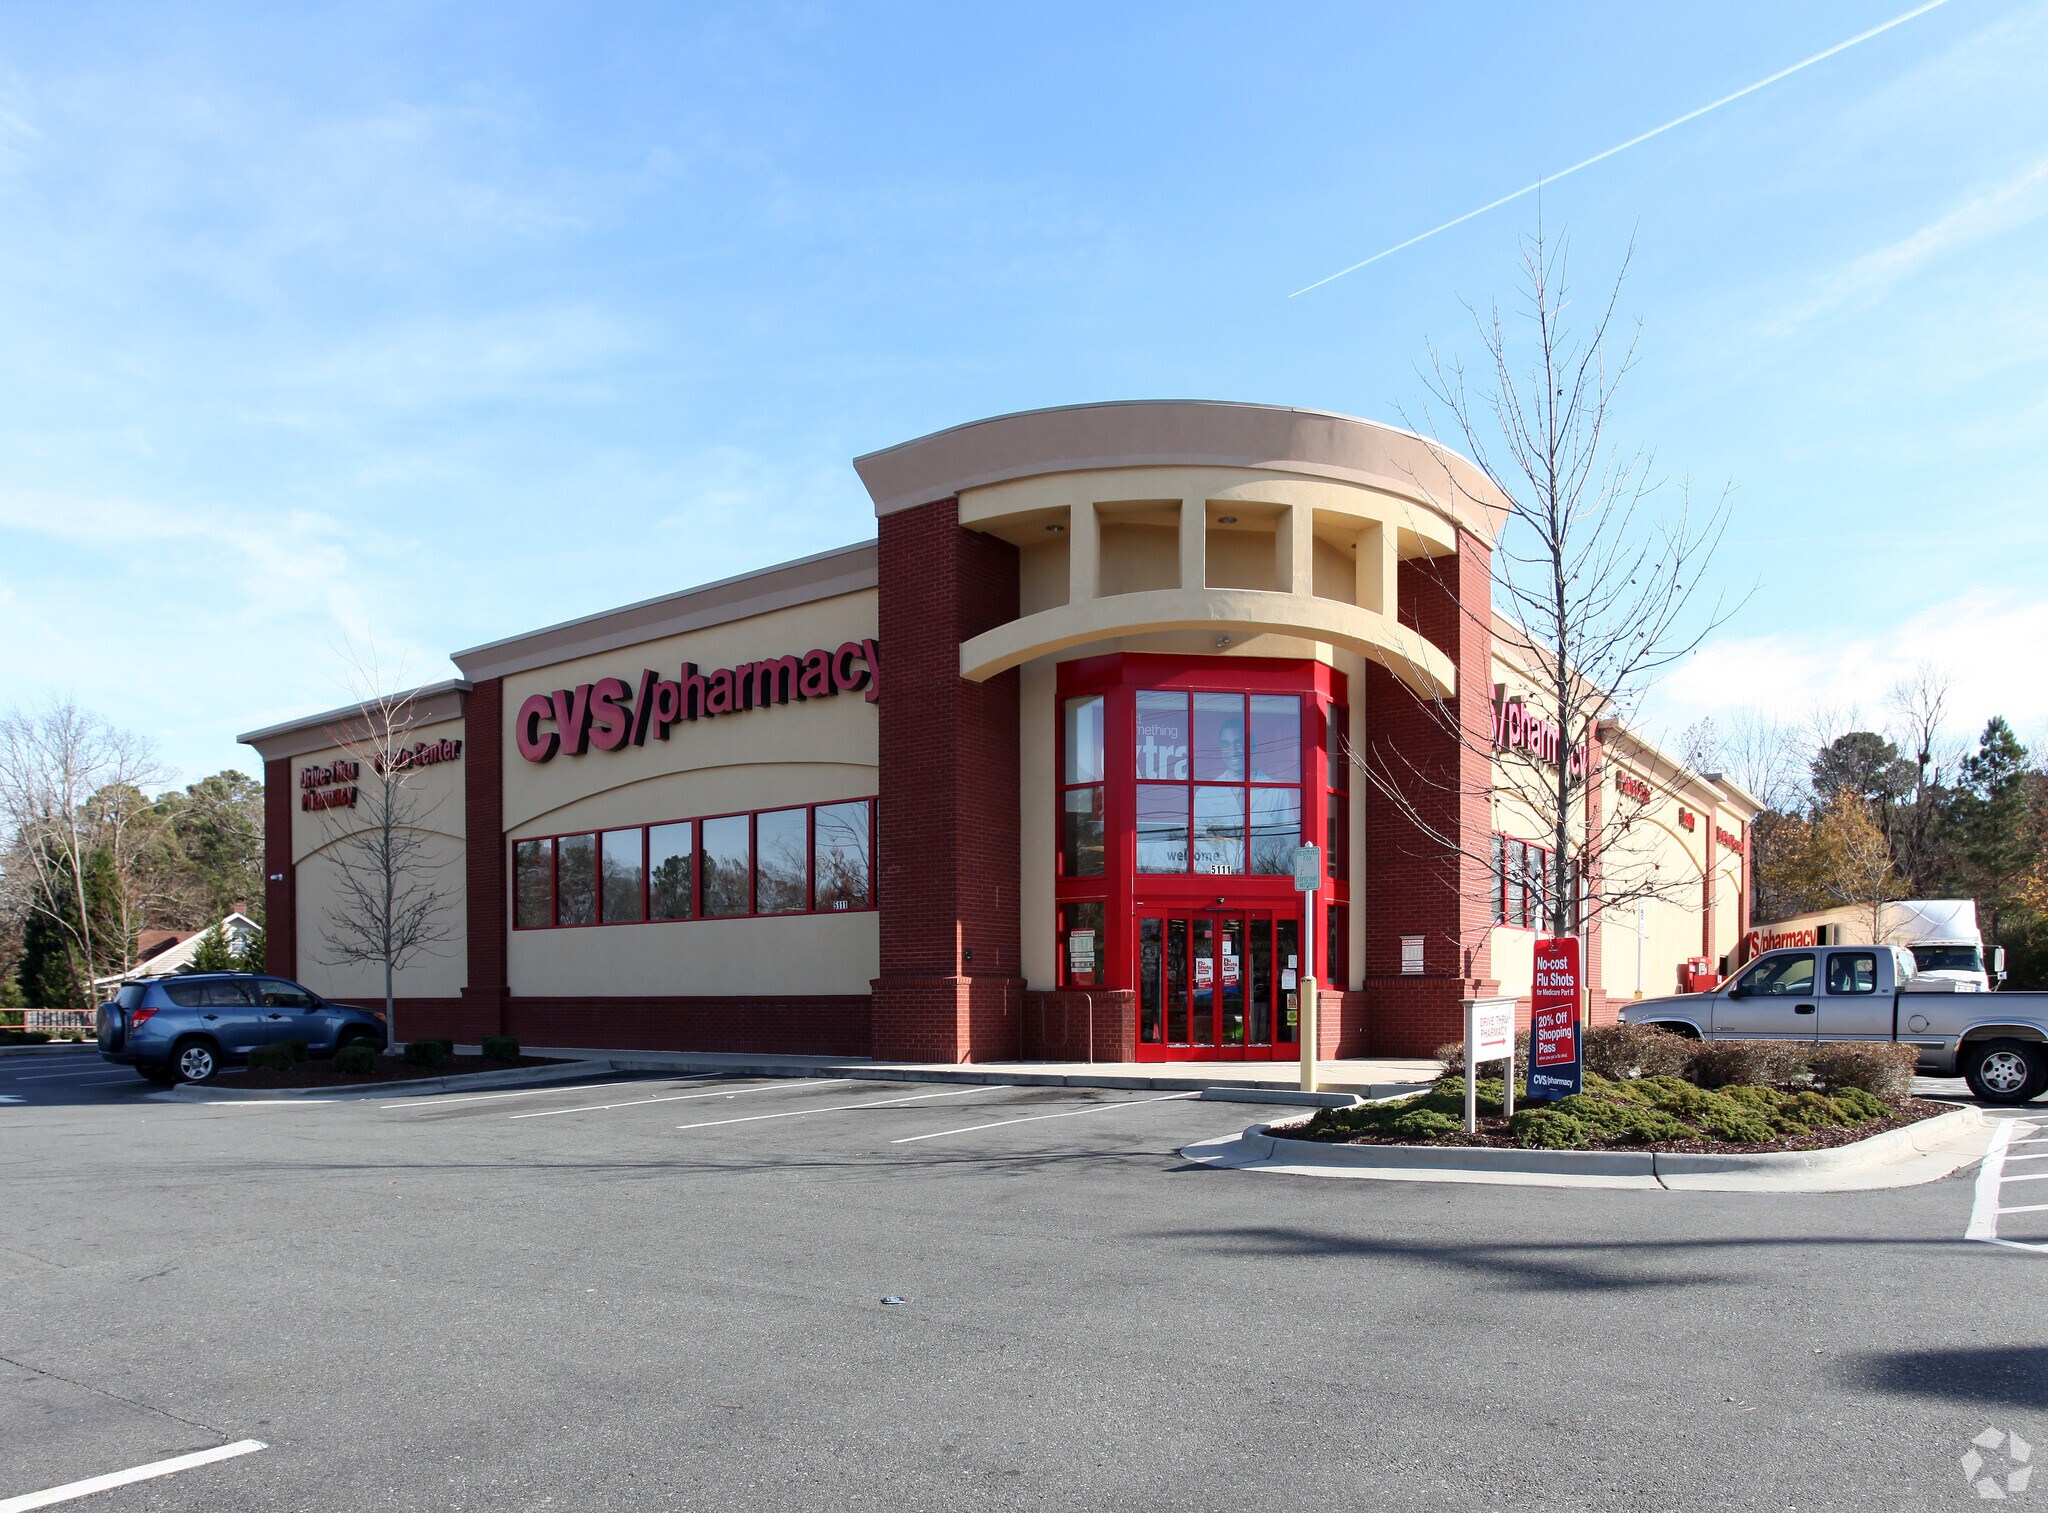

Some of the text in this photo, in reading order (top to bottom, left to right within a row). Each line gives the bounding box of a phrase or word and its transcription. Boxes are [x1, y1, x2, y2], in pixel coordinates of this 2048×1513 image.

[1167, 848, 1220, 861] welome
[1211, 865, 1232, 874] 5111
[833, 900, 848, 910] 5111
[1537, 956, 1568, 970] No-cost
[1536, 972, 1574, 987] Flu Shots
[1561, 988, 1570, 996] Part
[1480, 1016, 1495, 1027] DRIVE
[1539, 1011, 1568, 1028] 20% Off
[1480, 1025, 1507, 1038] PHARMACY
[1538, 1026, 1572, 1041] Shopping
[1539, 1042, 1556, 1054] Pass
[1533, 1074, 1574, 1089] CVS/pharmacy
